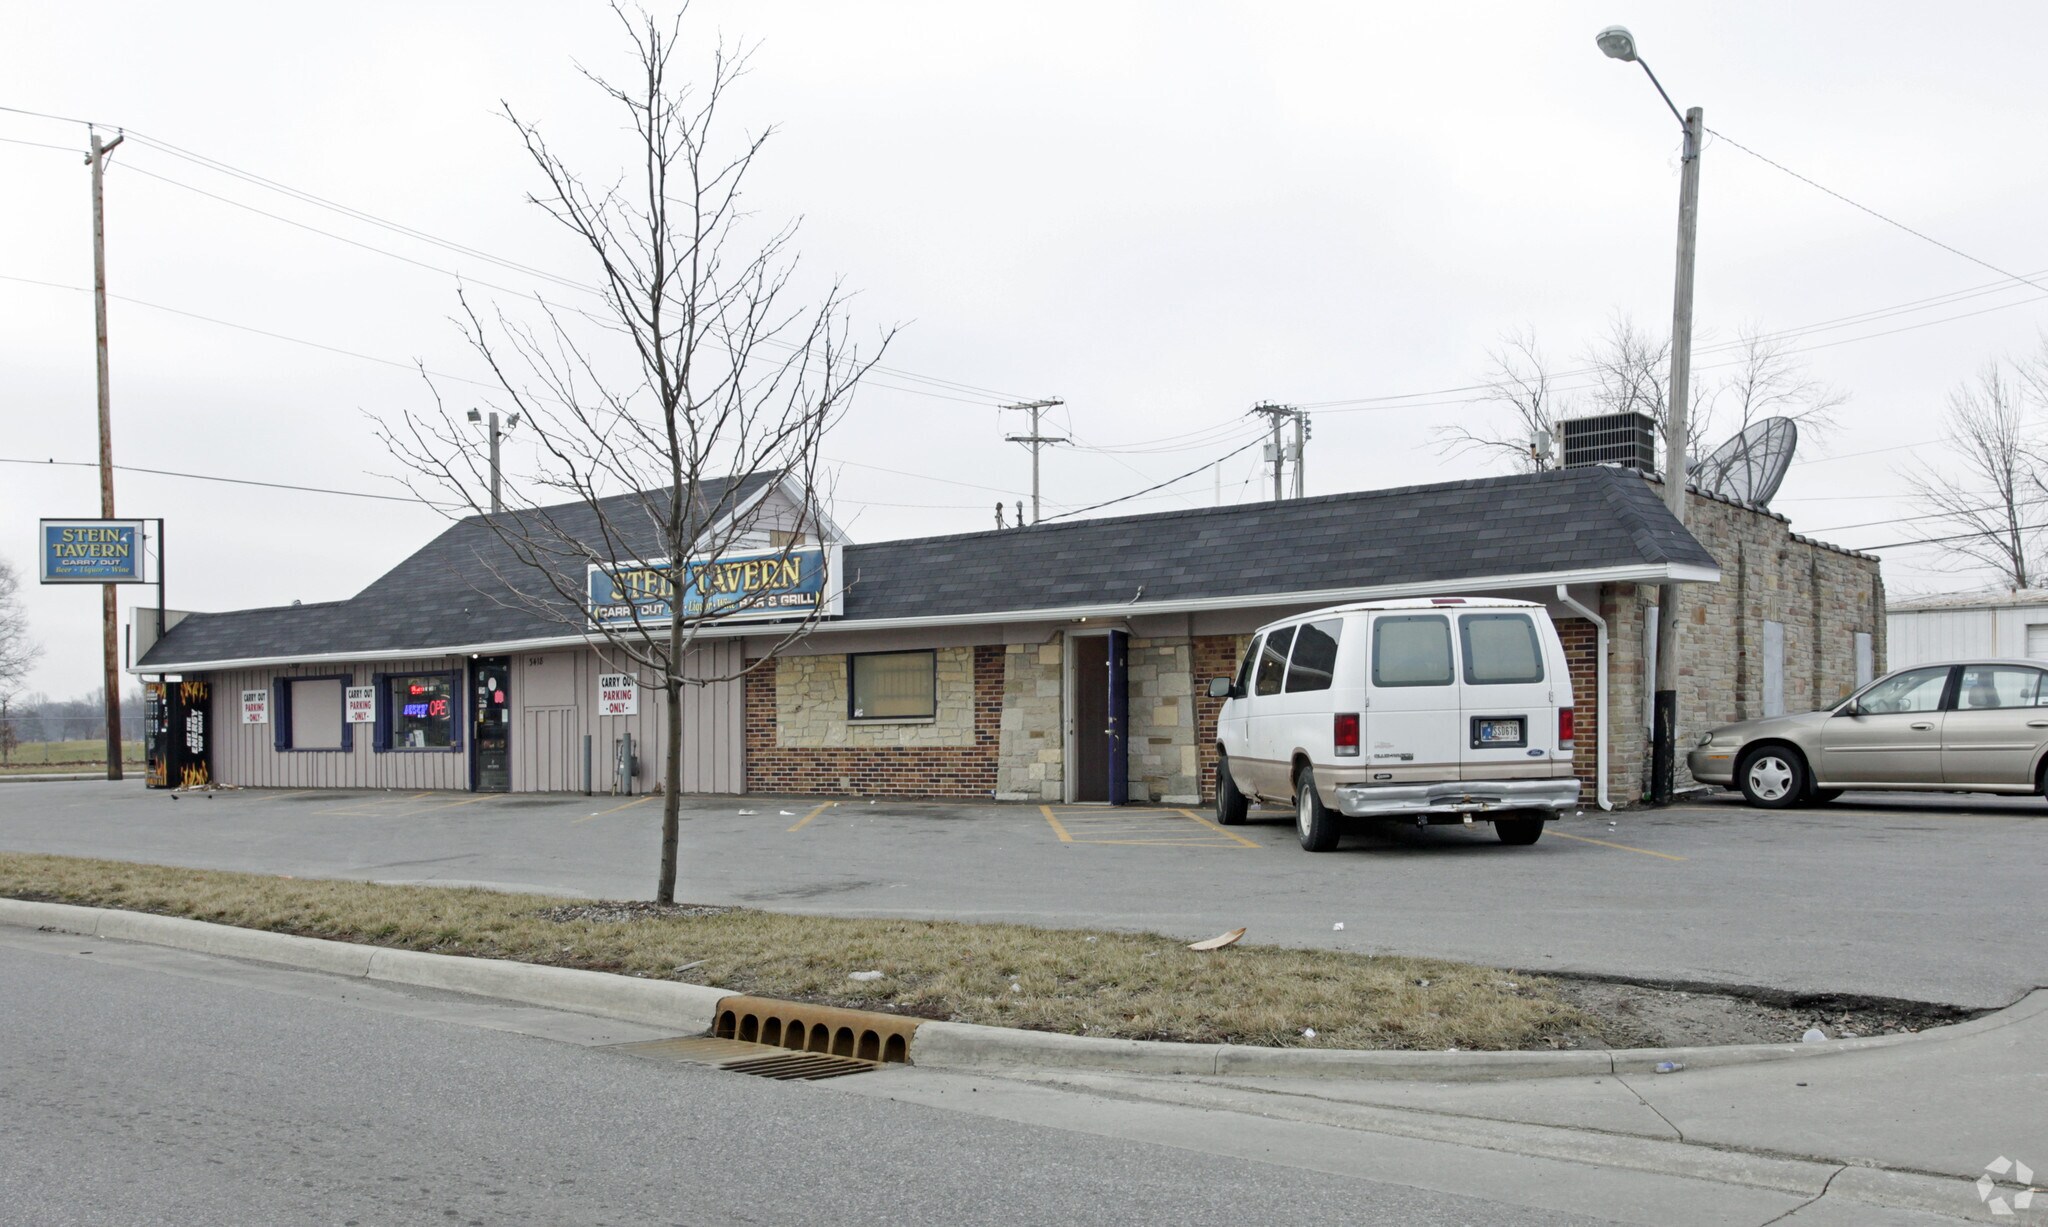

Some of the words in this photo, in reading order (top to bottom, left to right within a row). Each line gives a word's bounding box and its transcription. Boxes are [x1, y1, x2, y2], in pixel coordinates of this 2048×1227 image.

[62, 528, 120, 543] STEIN
[52, 543, 130, 557] TAVERN
[80, 566, 104, 575] Liquor
[610, 568, 686, 601] STEI
[693, 557, 801, 596] TAVERN
[768, 594, 778, 607] &
[780, 592, 815, 606] GRILL
[600, 605, 637, 618] CARR
[641, 604, 664, 616] OUT
[601, 676, 620, 688] CARRY
[244, 693, 256, 702] CARRY
[257, 692, 266, 701] OUT
[348, 689, 362, 699] CARRY
[364, 688, 373, 698] OUT
[603, 690, 632, 701] PARKING
[245, 703, 265, 712] PARKING
[350, 700, 371, 711] PARKING
[191, 708, 199, 754] ENERGY
